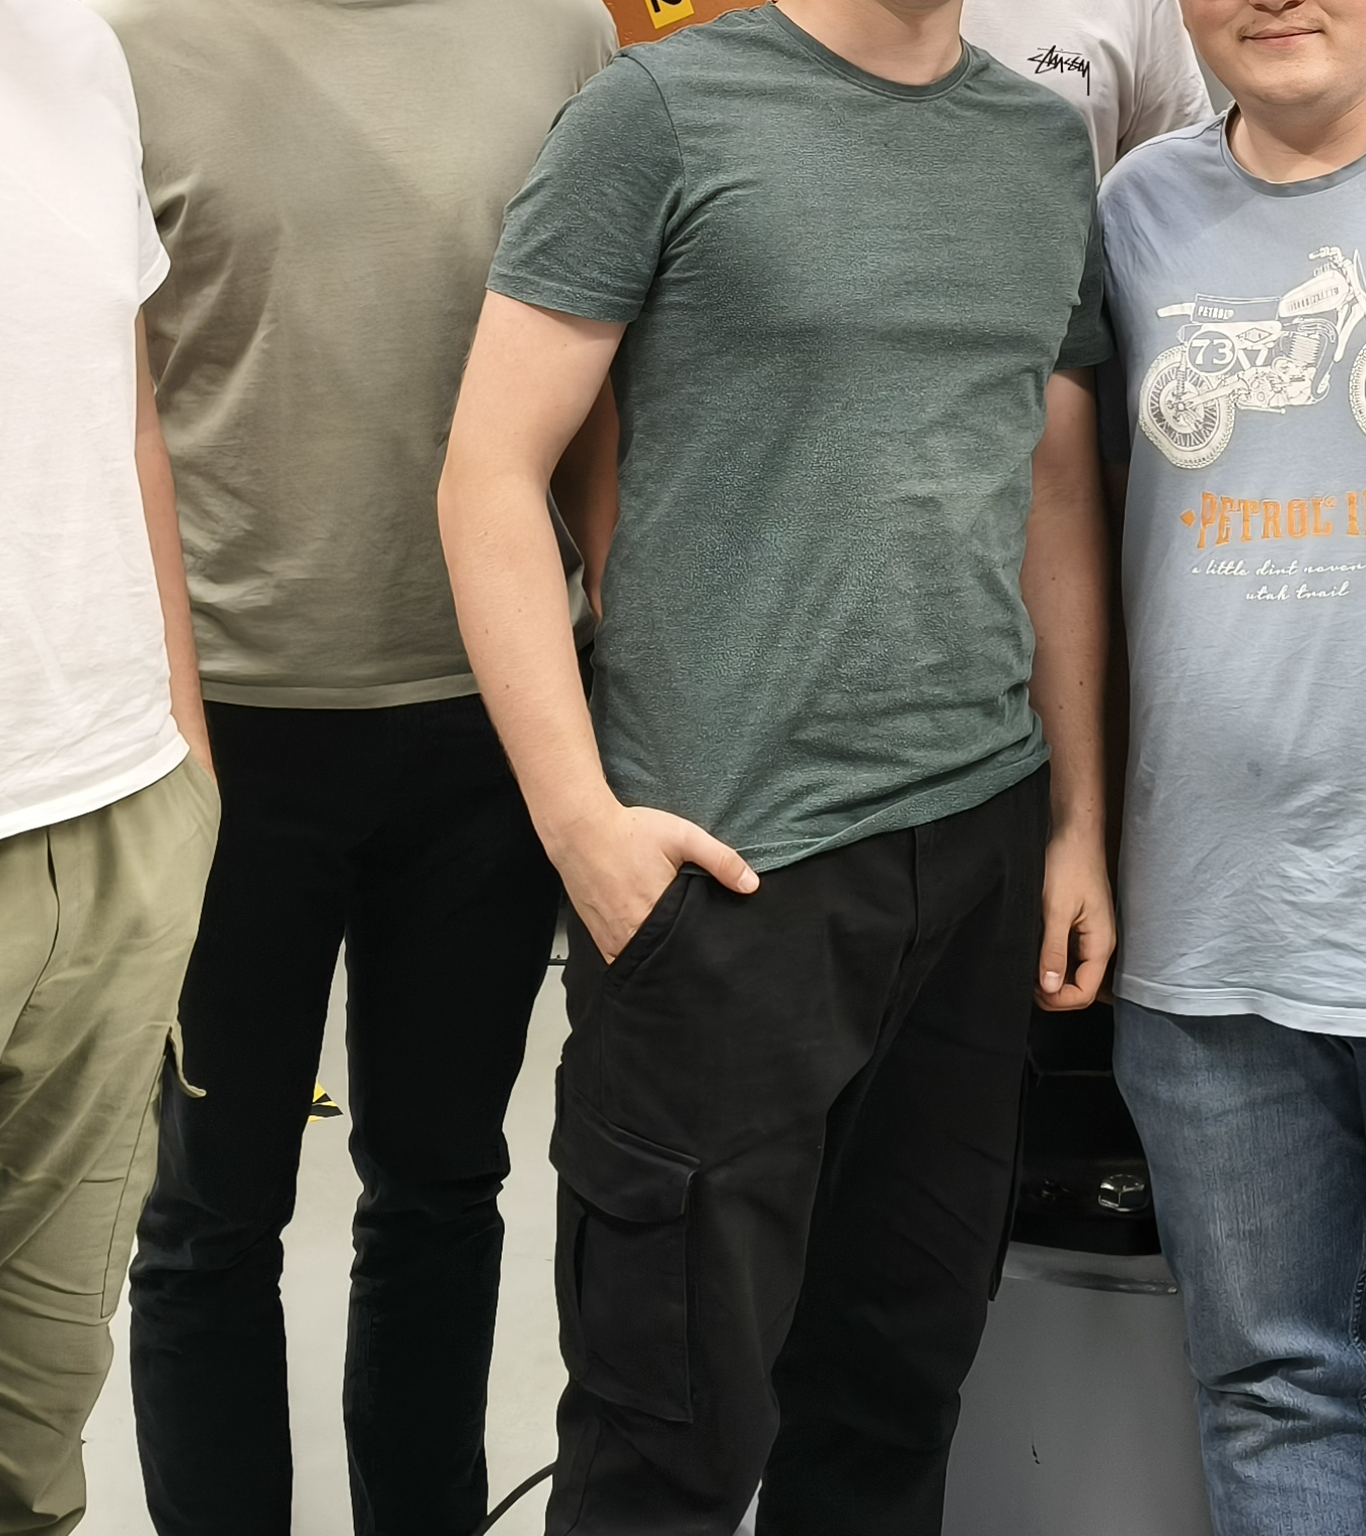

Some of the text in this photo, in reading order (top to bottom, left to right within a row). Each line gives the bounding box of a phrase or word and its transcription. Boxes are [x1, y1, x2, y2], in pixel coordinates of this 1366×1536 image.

[1191, 338, 1234, 365] 73
[1205, 559, 1250, 576] little
[1245, 581, 1350, 601] utah trail
